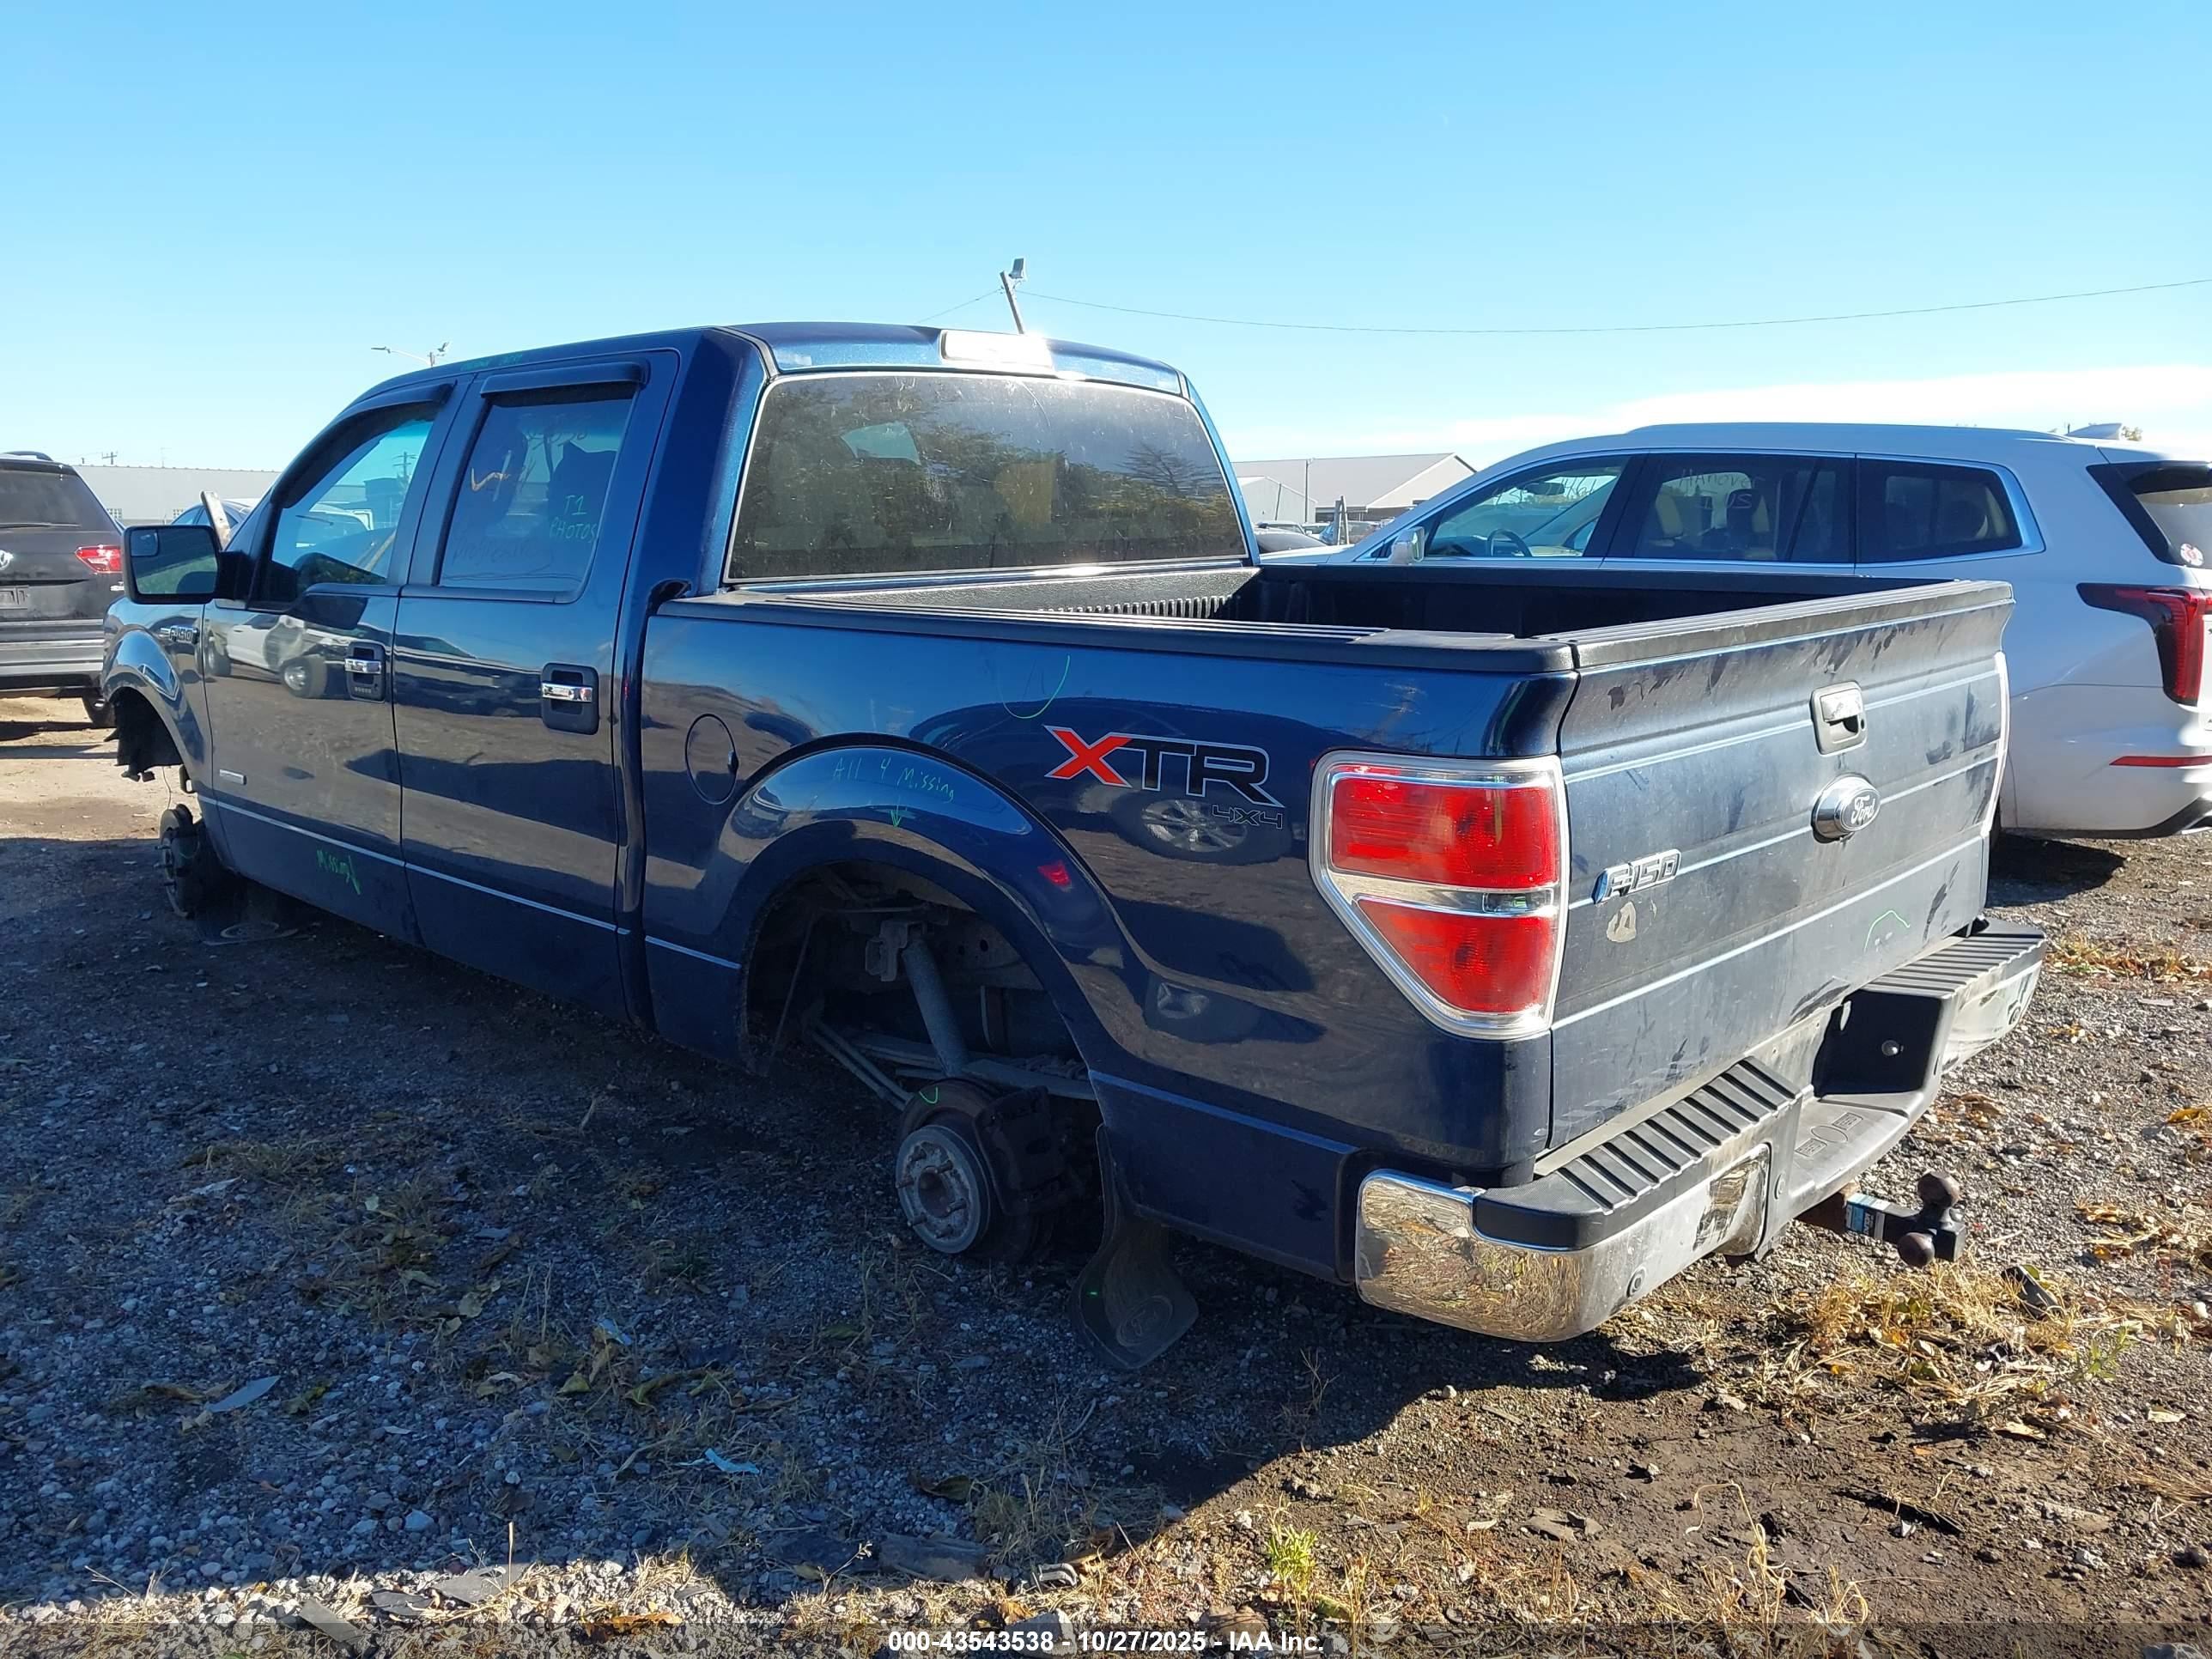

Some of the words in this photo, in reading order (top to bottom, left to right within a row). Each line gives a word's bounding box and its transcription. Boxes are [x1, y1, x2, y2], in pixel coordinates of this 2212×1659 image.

[550, 517, 598, 544] PHOTOS
[834, 757, 862, 781] All
[880, 757, 892, 782] 4
[896, 767, 955, 804] Missing
[1042, 724, 1285, 808] XTR
[1850, 794, 1876, 825] Ford
